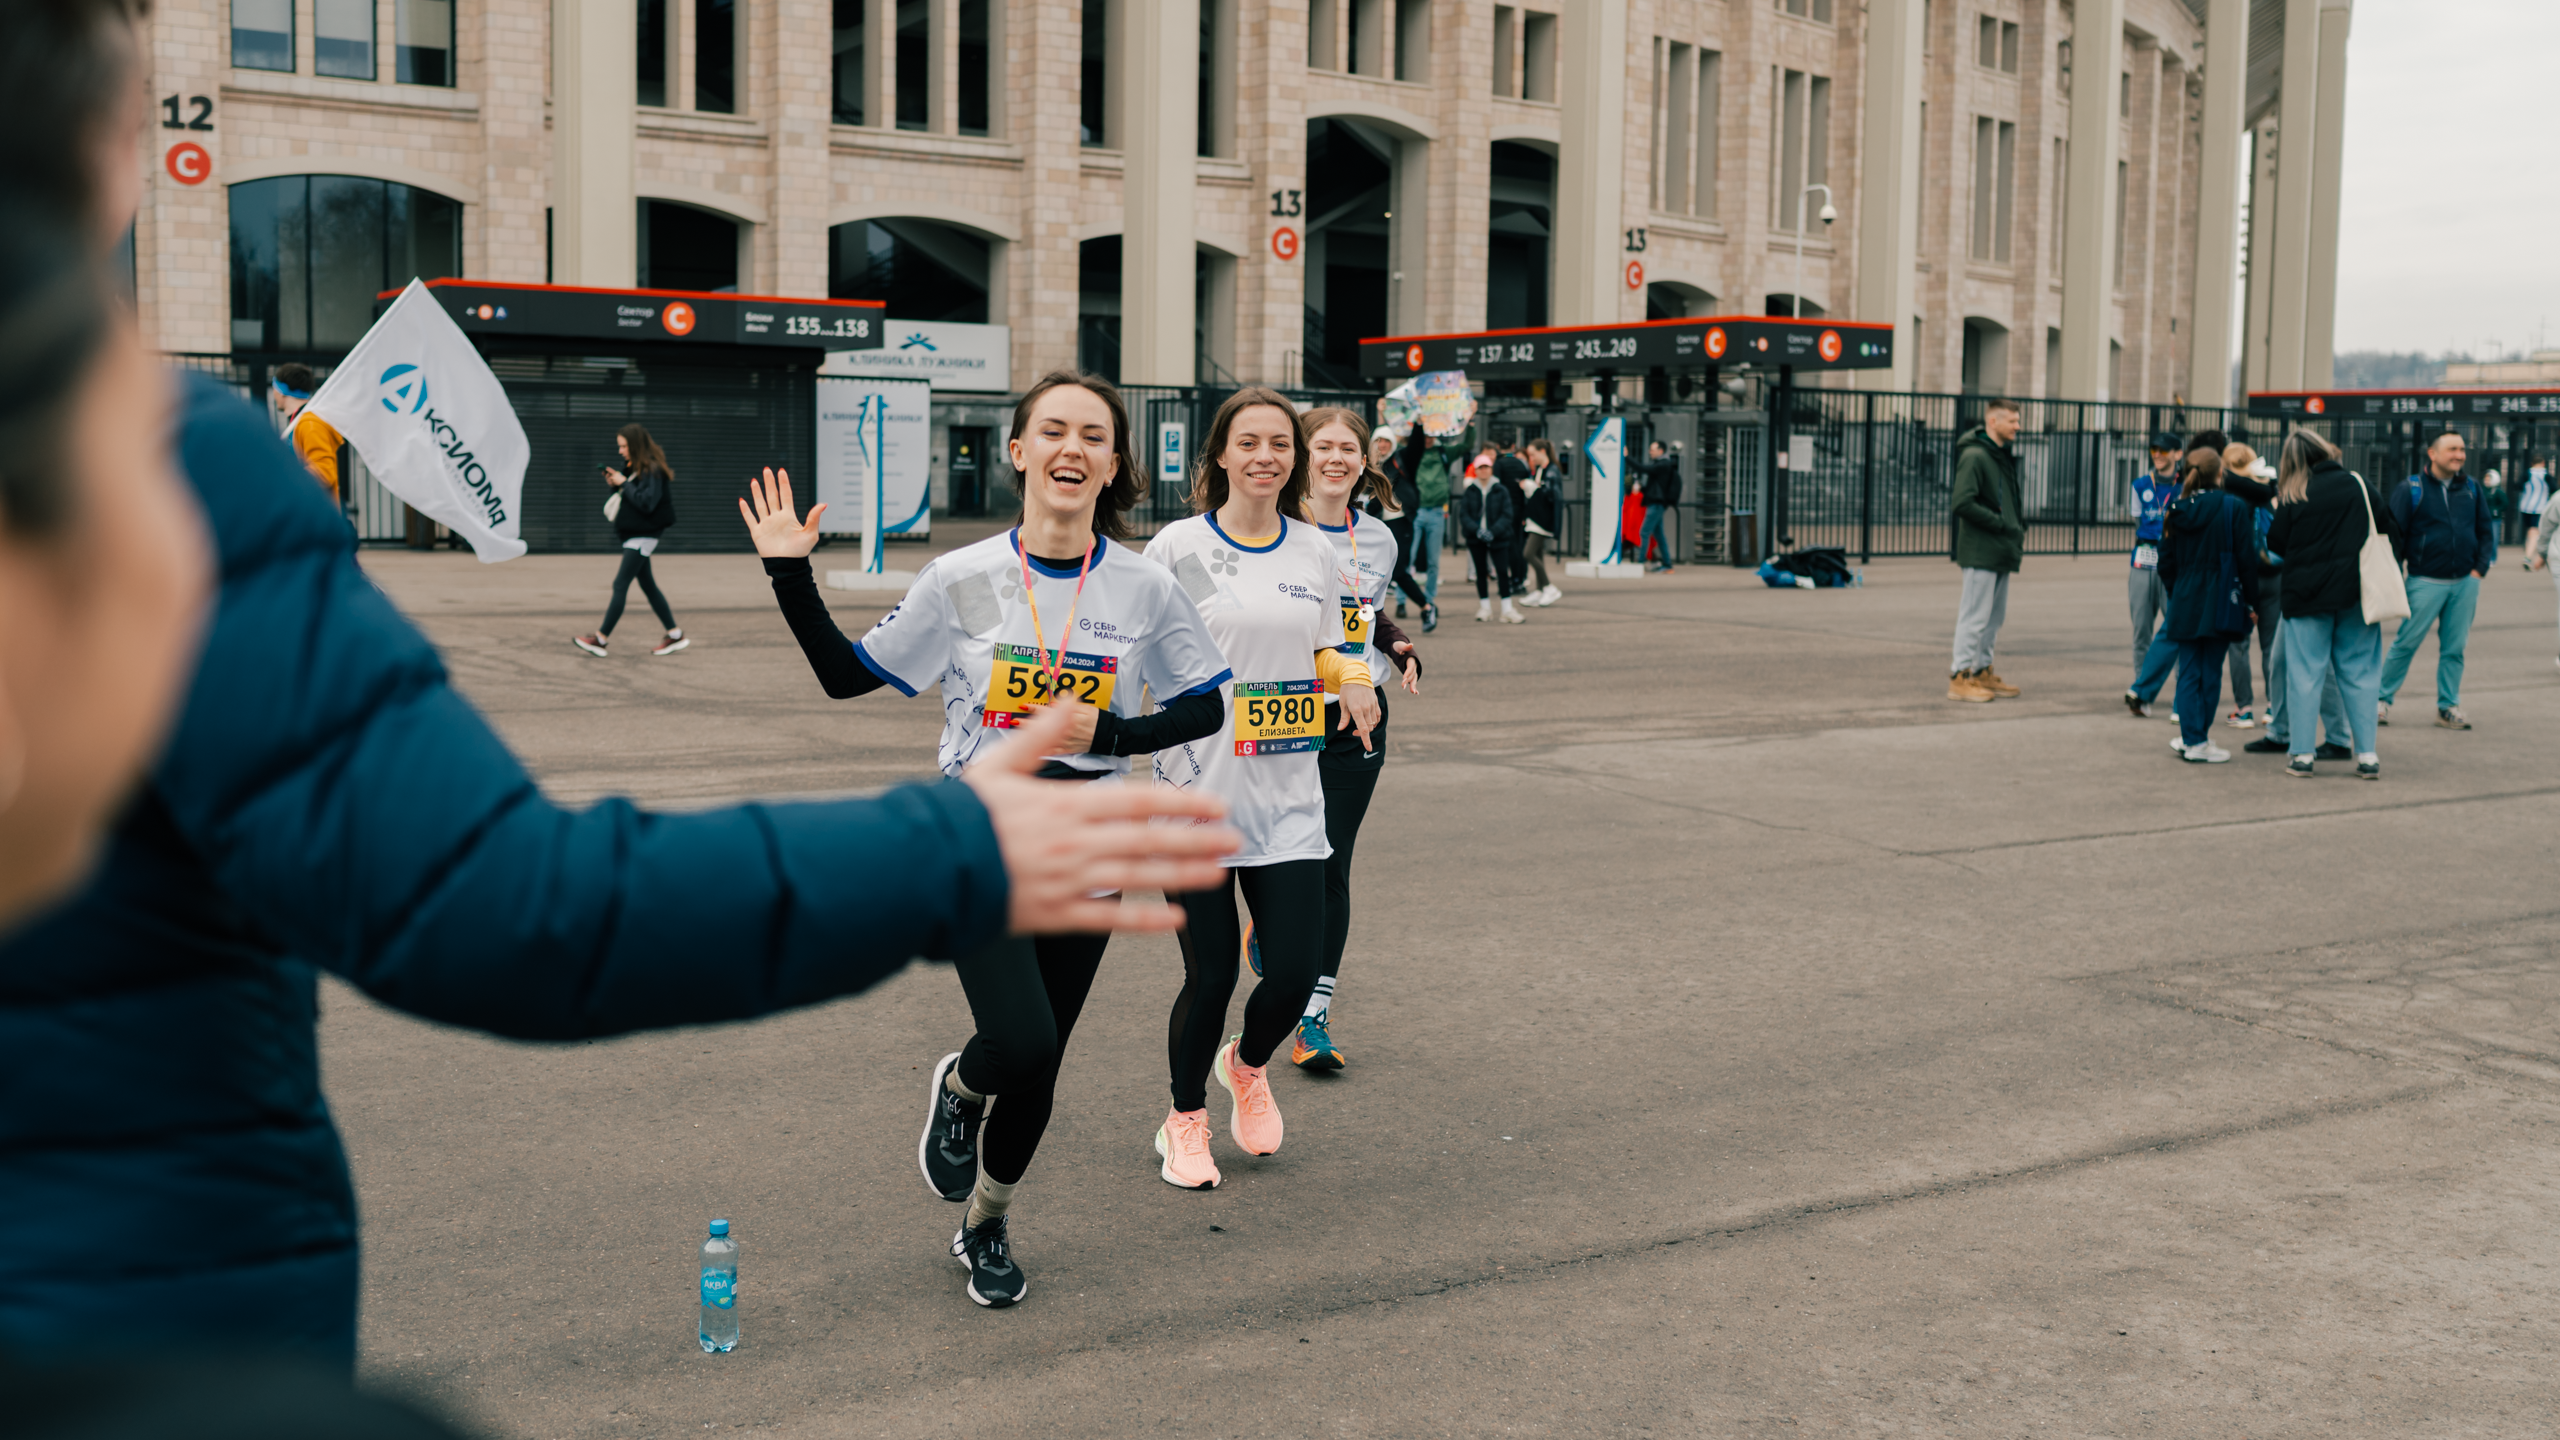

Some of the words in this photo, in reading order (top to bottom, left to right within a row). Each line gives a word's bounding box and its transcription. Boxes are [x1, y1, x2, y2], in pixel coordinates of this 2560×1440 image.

[162, 94, 214, 131] 12
[175, 150, 200, 178] C
[1271, 190, 1301, 217] 13
[1626, 228, 1646, 252] 13
[786, 316, 869, 338] 135...138
[1094, 621, 1116, 632] СБЕР
[1006, 666, 1100, 704] 5982
[1248, 683, 1278, 691] АПРЕЛЬ
[994, 713, 1006, 726] F
[1248, 697, 1315, 727] 5980
[1259, 727, 1306, 737] ЕЛИЗАВЕТА
[1243, 742, 1253, 754] G
[704, 1280, 728, 1291] АКВА
